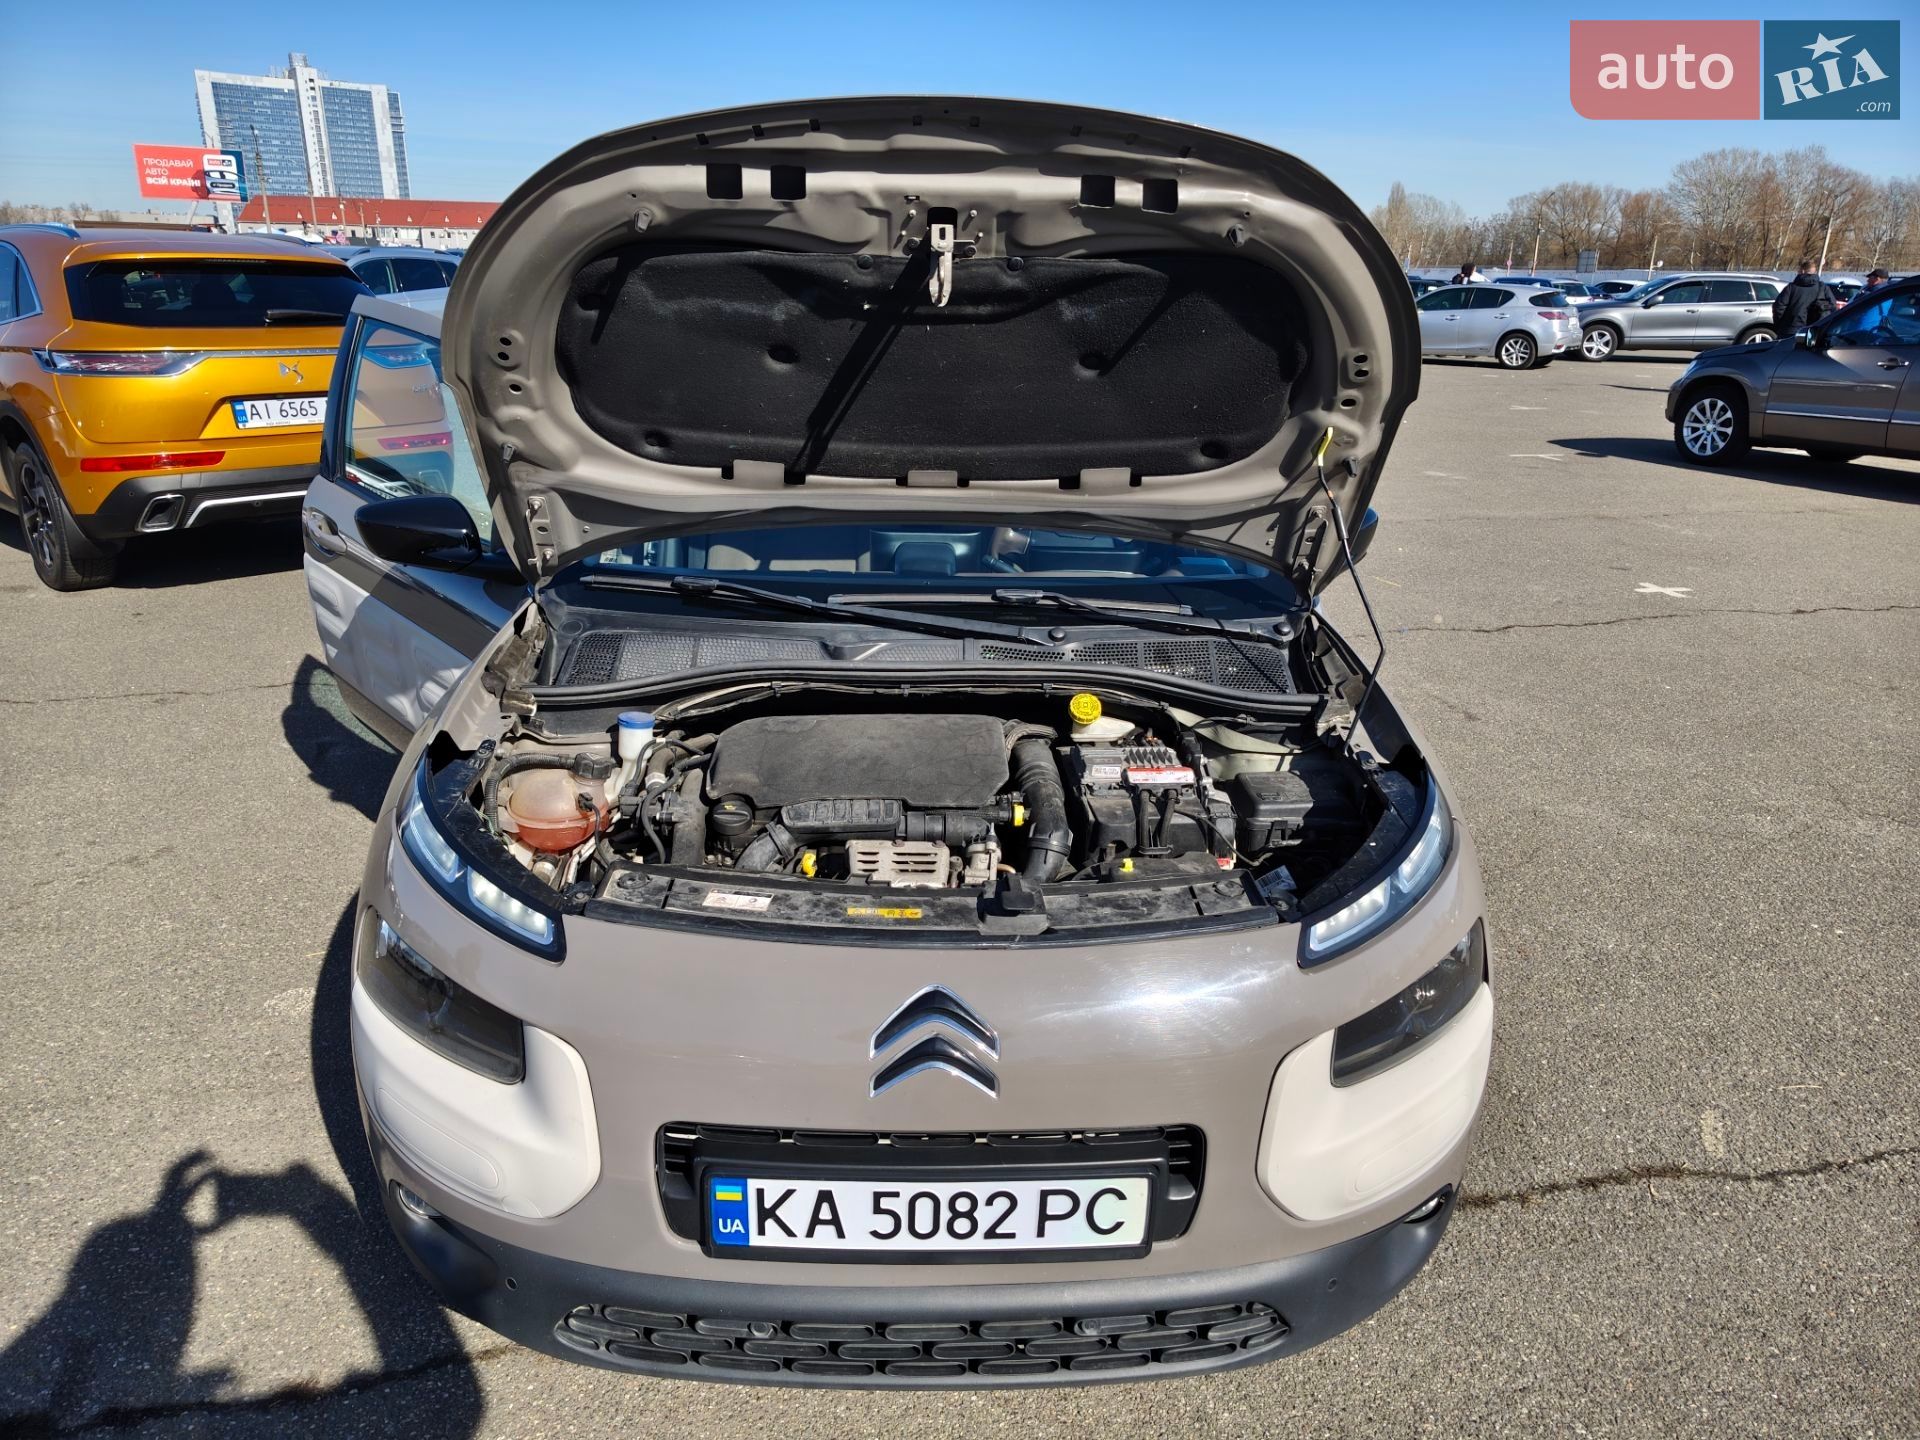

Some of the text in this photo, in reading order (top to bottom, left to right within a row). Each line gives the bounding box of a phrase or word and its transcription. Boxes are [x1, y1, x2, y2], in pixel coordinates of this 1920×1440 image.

[143, 157, 194, 168] ПРОДАВАЙ
[144, 167, 169, 176] АВТО
[250, 400, 318, 420] AI 6565
[755, 1187, 1128, 1240] KA 5082 PC
[718, 1217, 746, 1234] UA
